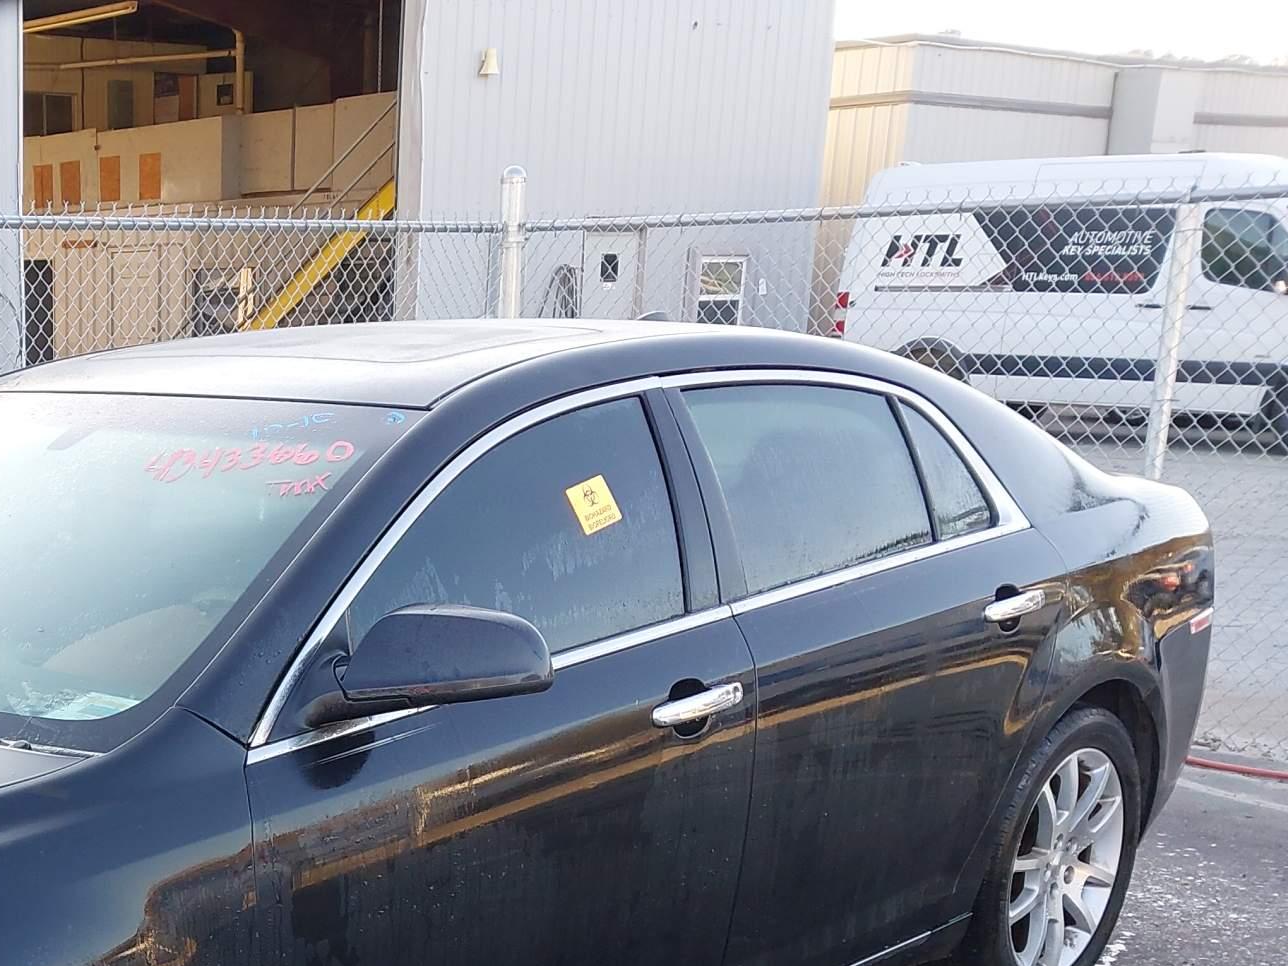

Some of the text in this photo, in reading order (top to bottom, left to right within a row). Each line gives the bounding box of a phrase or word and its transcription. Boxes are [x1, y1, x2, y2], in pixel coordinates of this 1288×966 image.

[1069, 230, 1154, 244] AUTOMOTIVE
[881, 234, 963, 267] HTL
[1062, 245, 1152, 255] KEY SPECIALISTS
